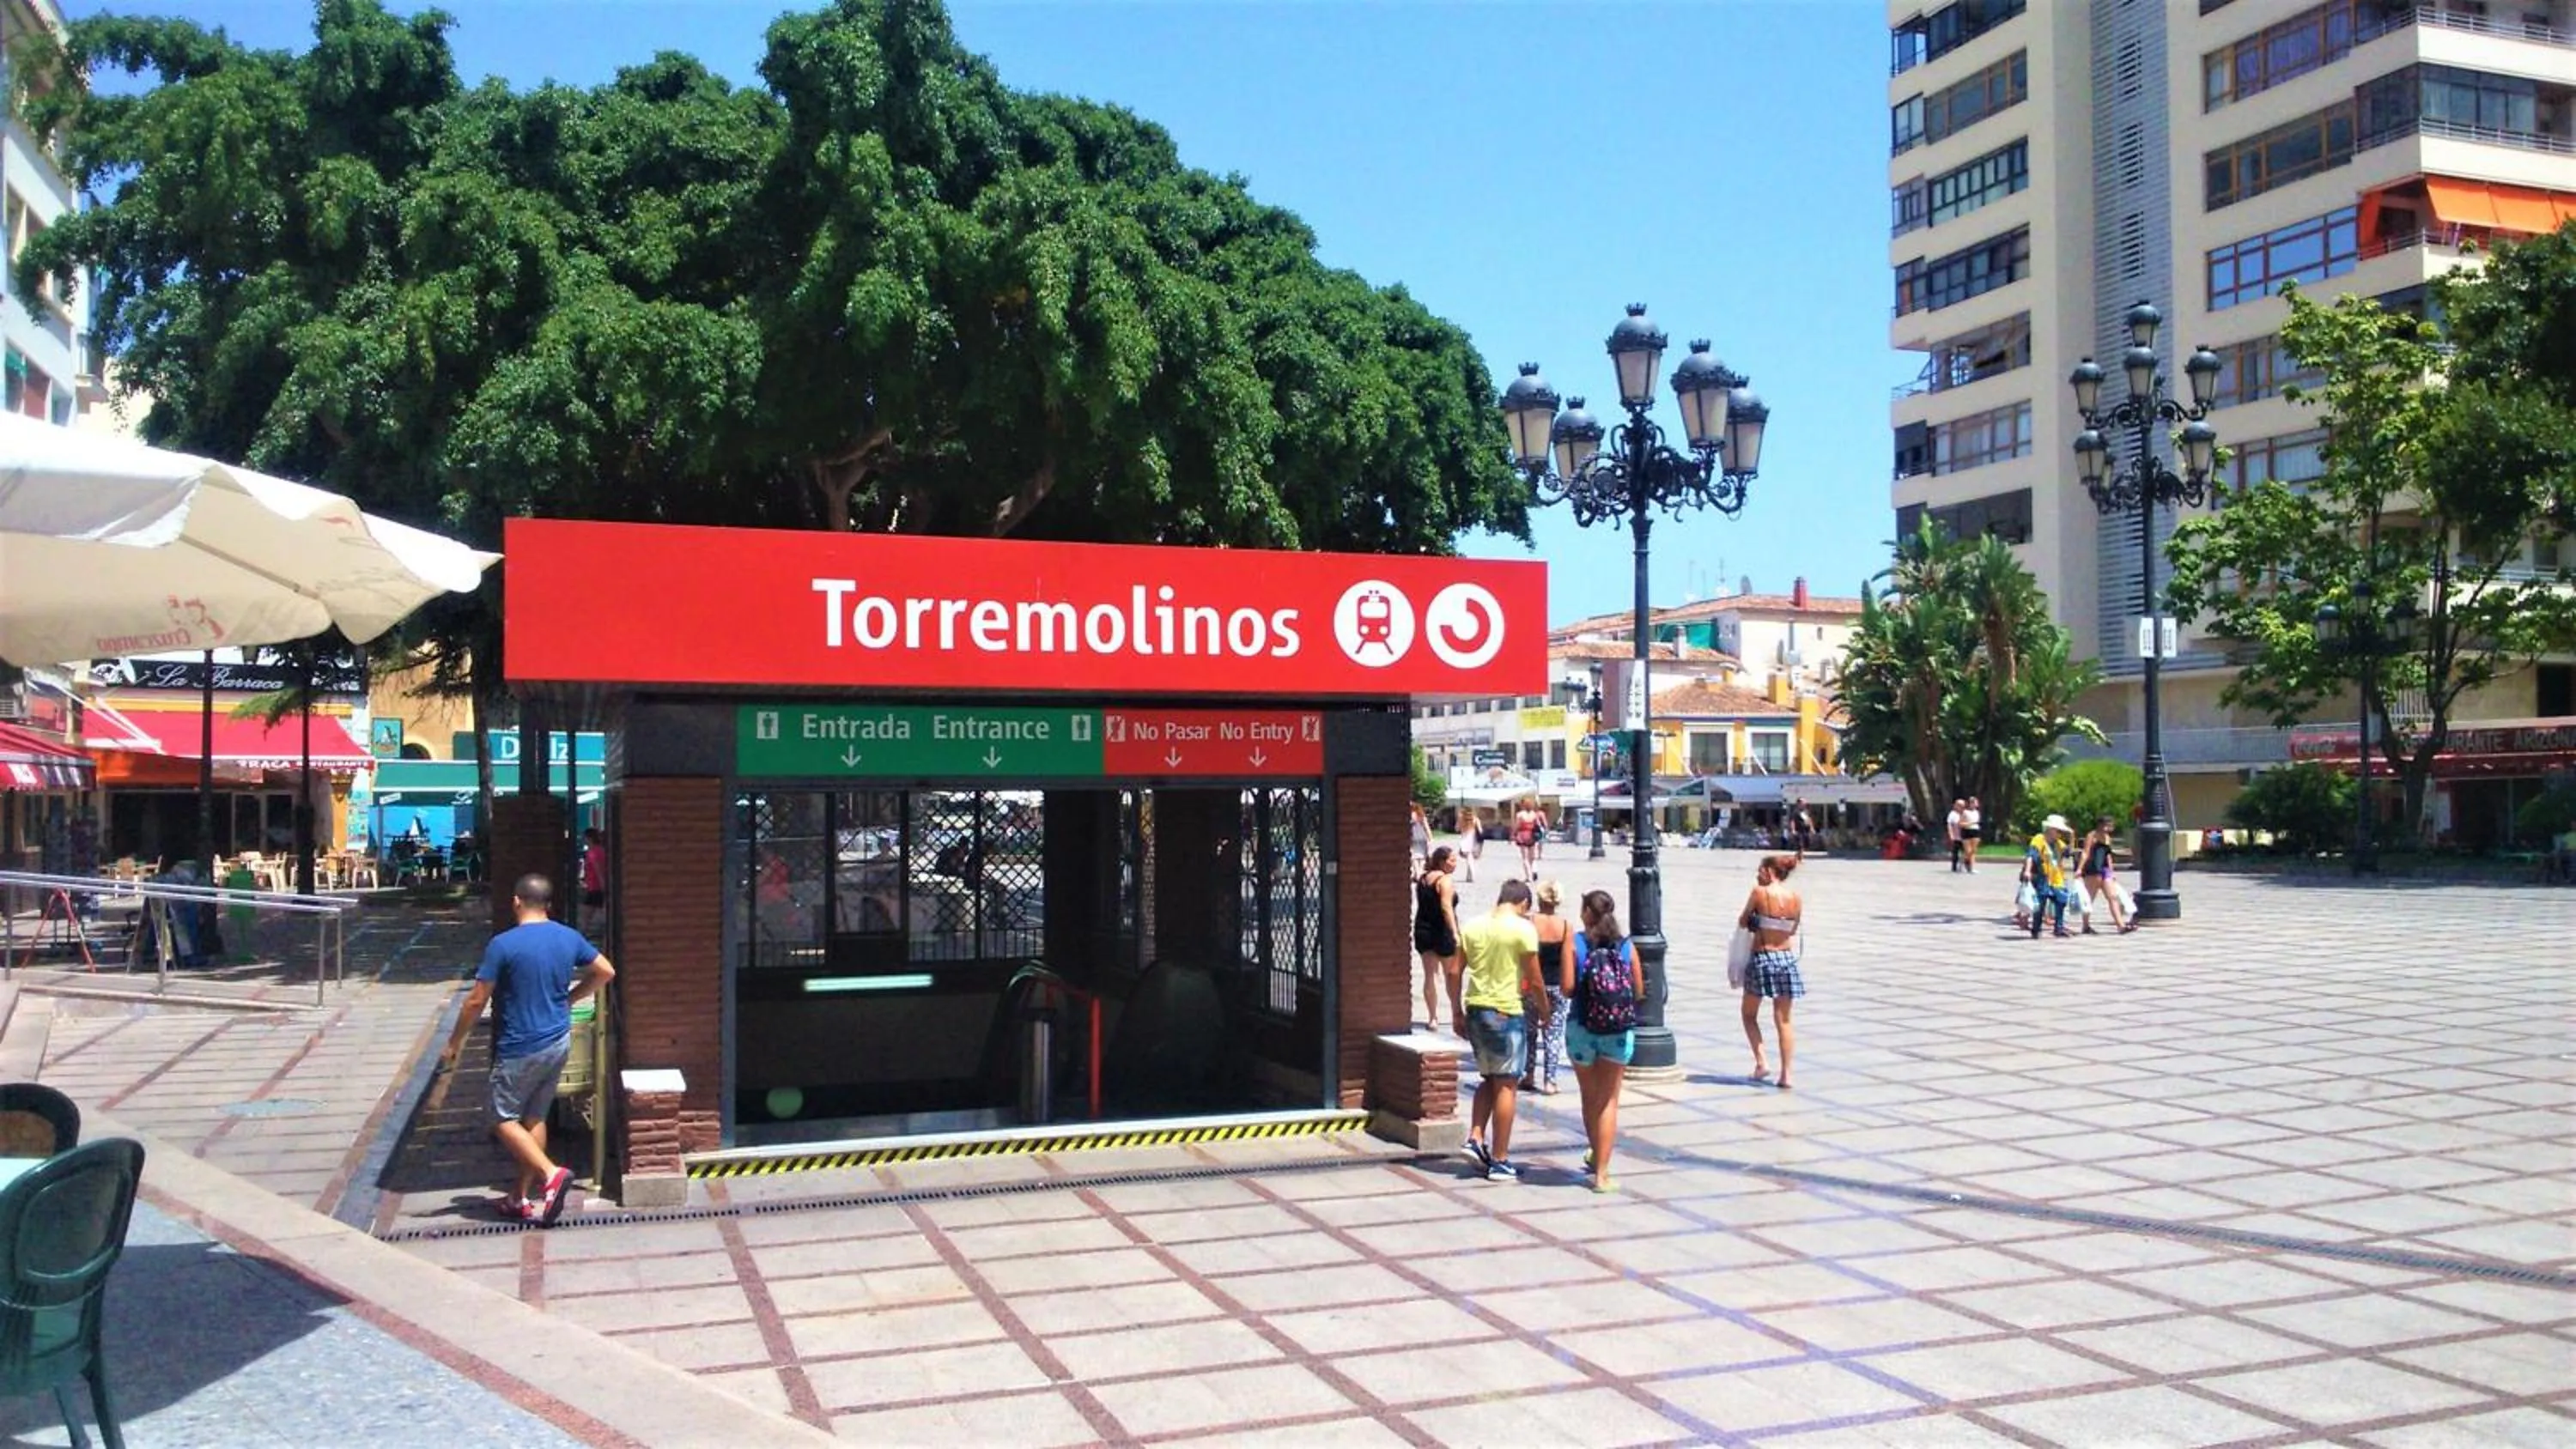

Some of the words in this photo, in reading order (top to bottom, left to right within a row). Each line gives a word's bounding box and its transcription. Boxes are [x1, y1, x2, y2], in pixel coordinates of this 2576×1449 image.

[811, 579, 1301, 658] Torremolinos
[149, 664, 188, 688] La
[196, 664, 284, 689] Barraca
[802, 713, 911, 740] Entrada
[933, 715, 1050, 741] Entrance
[1133, 723, 1158, 740] No
[1165, 722, 1212, 740] Pasar
[1220, 723, 1244, 740] No
[1251, 722, 1293, 744] Entry
